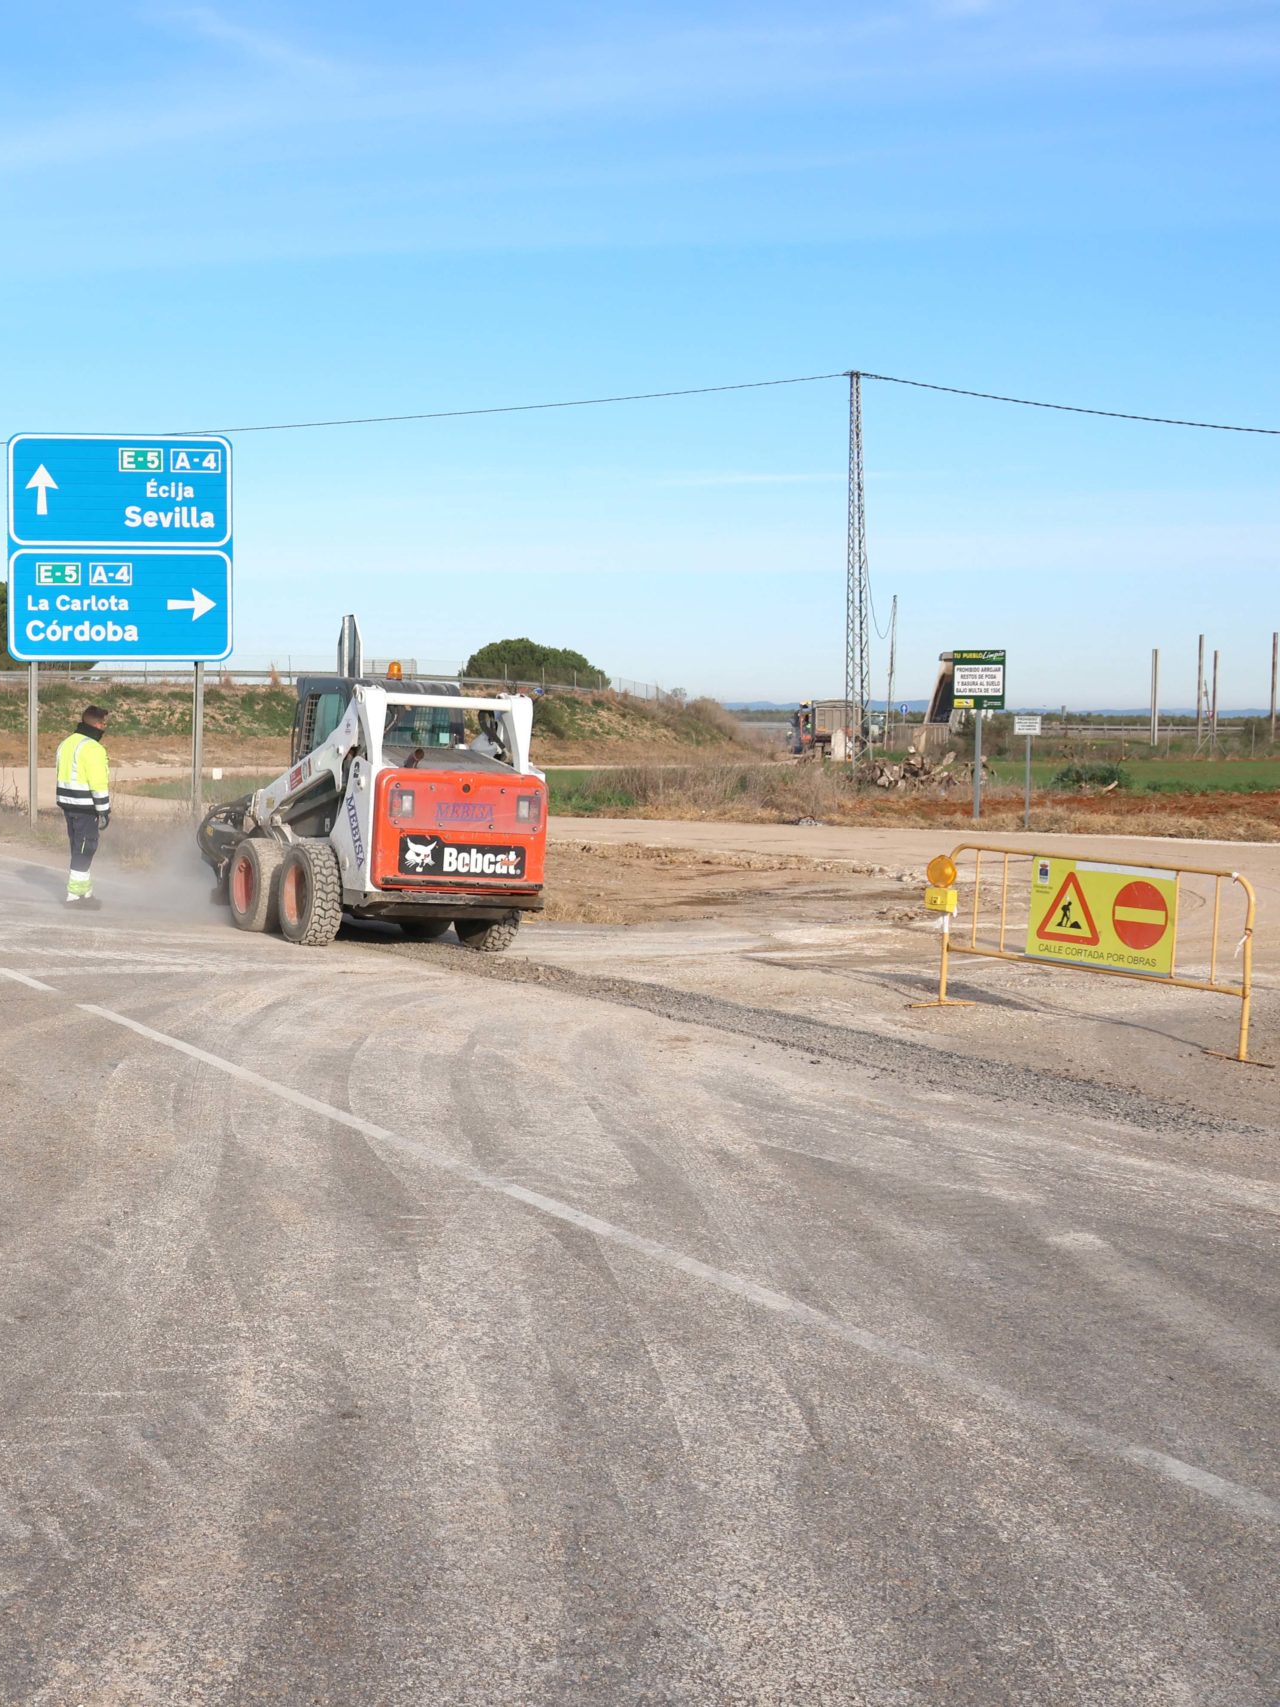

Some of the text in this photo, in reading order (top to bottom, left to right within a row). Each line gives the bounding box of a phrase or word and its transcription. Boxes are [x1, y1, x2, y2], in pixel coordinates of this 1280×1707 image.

[122, 451, 216, 470] E-5 A-4
[146, 479, 194, 501] Écija
[124, 506, 215, 528] Sevilla
[39, 565, 130, 583] E-5 A-4
[27, 595, 129, 611] La Carlota
[25, 620, 139, 642] Córdoba
[435, 803, 496, 821] MEBISA
[346, 793, 366, 870] MEBISA
[443, 847, 516, 875] Bobcat
[1038, 943, 1157, 967] CALLE CORTADA POR OBRAS
